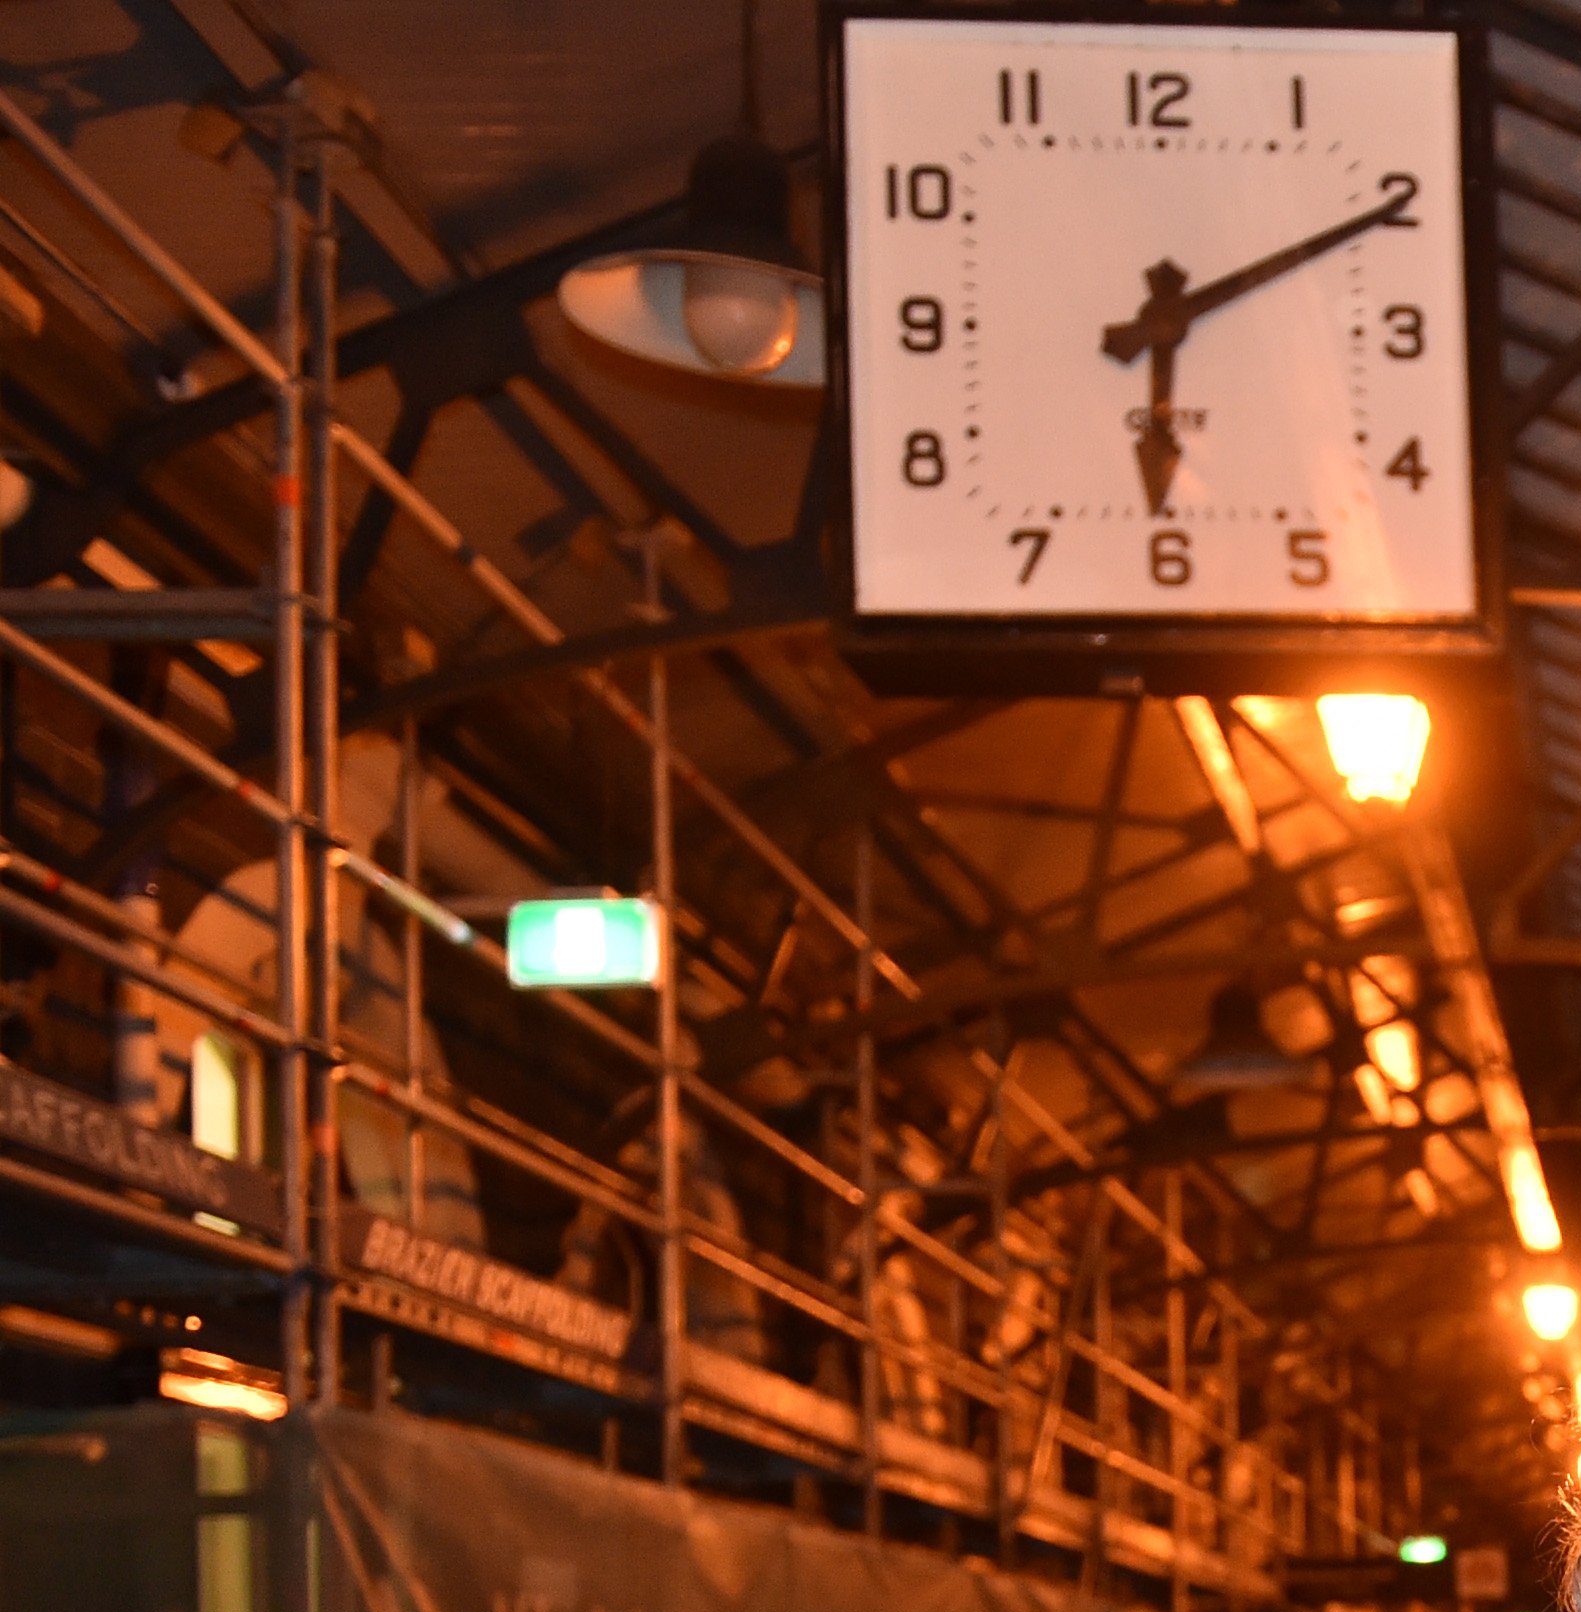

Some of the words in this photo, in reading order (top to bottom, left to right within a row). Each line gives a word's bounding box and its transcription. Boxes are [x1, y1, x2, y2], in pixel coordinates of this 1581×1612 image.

[997, 67, 1042, 128] 11
[1125, 70, 1192, 131] 12
[1290, 74, 1306, 132] 1
[884, 162, 954, 224] 10
[1378, 170, 1421, 231] 2
[897, 294, 946, 356] 9
[1381, 303, 1426, 362] 3
[900, 428, 948, 490] 8
[1384, 436, 1431, 493] 4
[1007, 527, 1053, 586] 7
[1147, 528, 1194, 589] 6
[1286, 529, 1332, 588] 5
[475, 1262, 632, 1360] SCAFFOLDING
